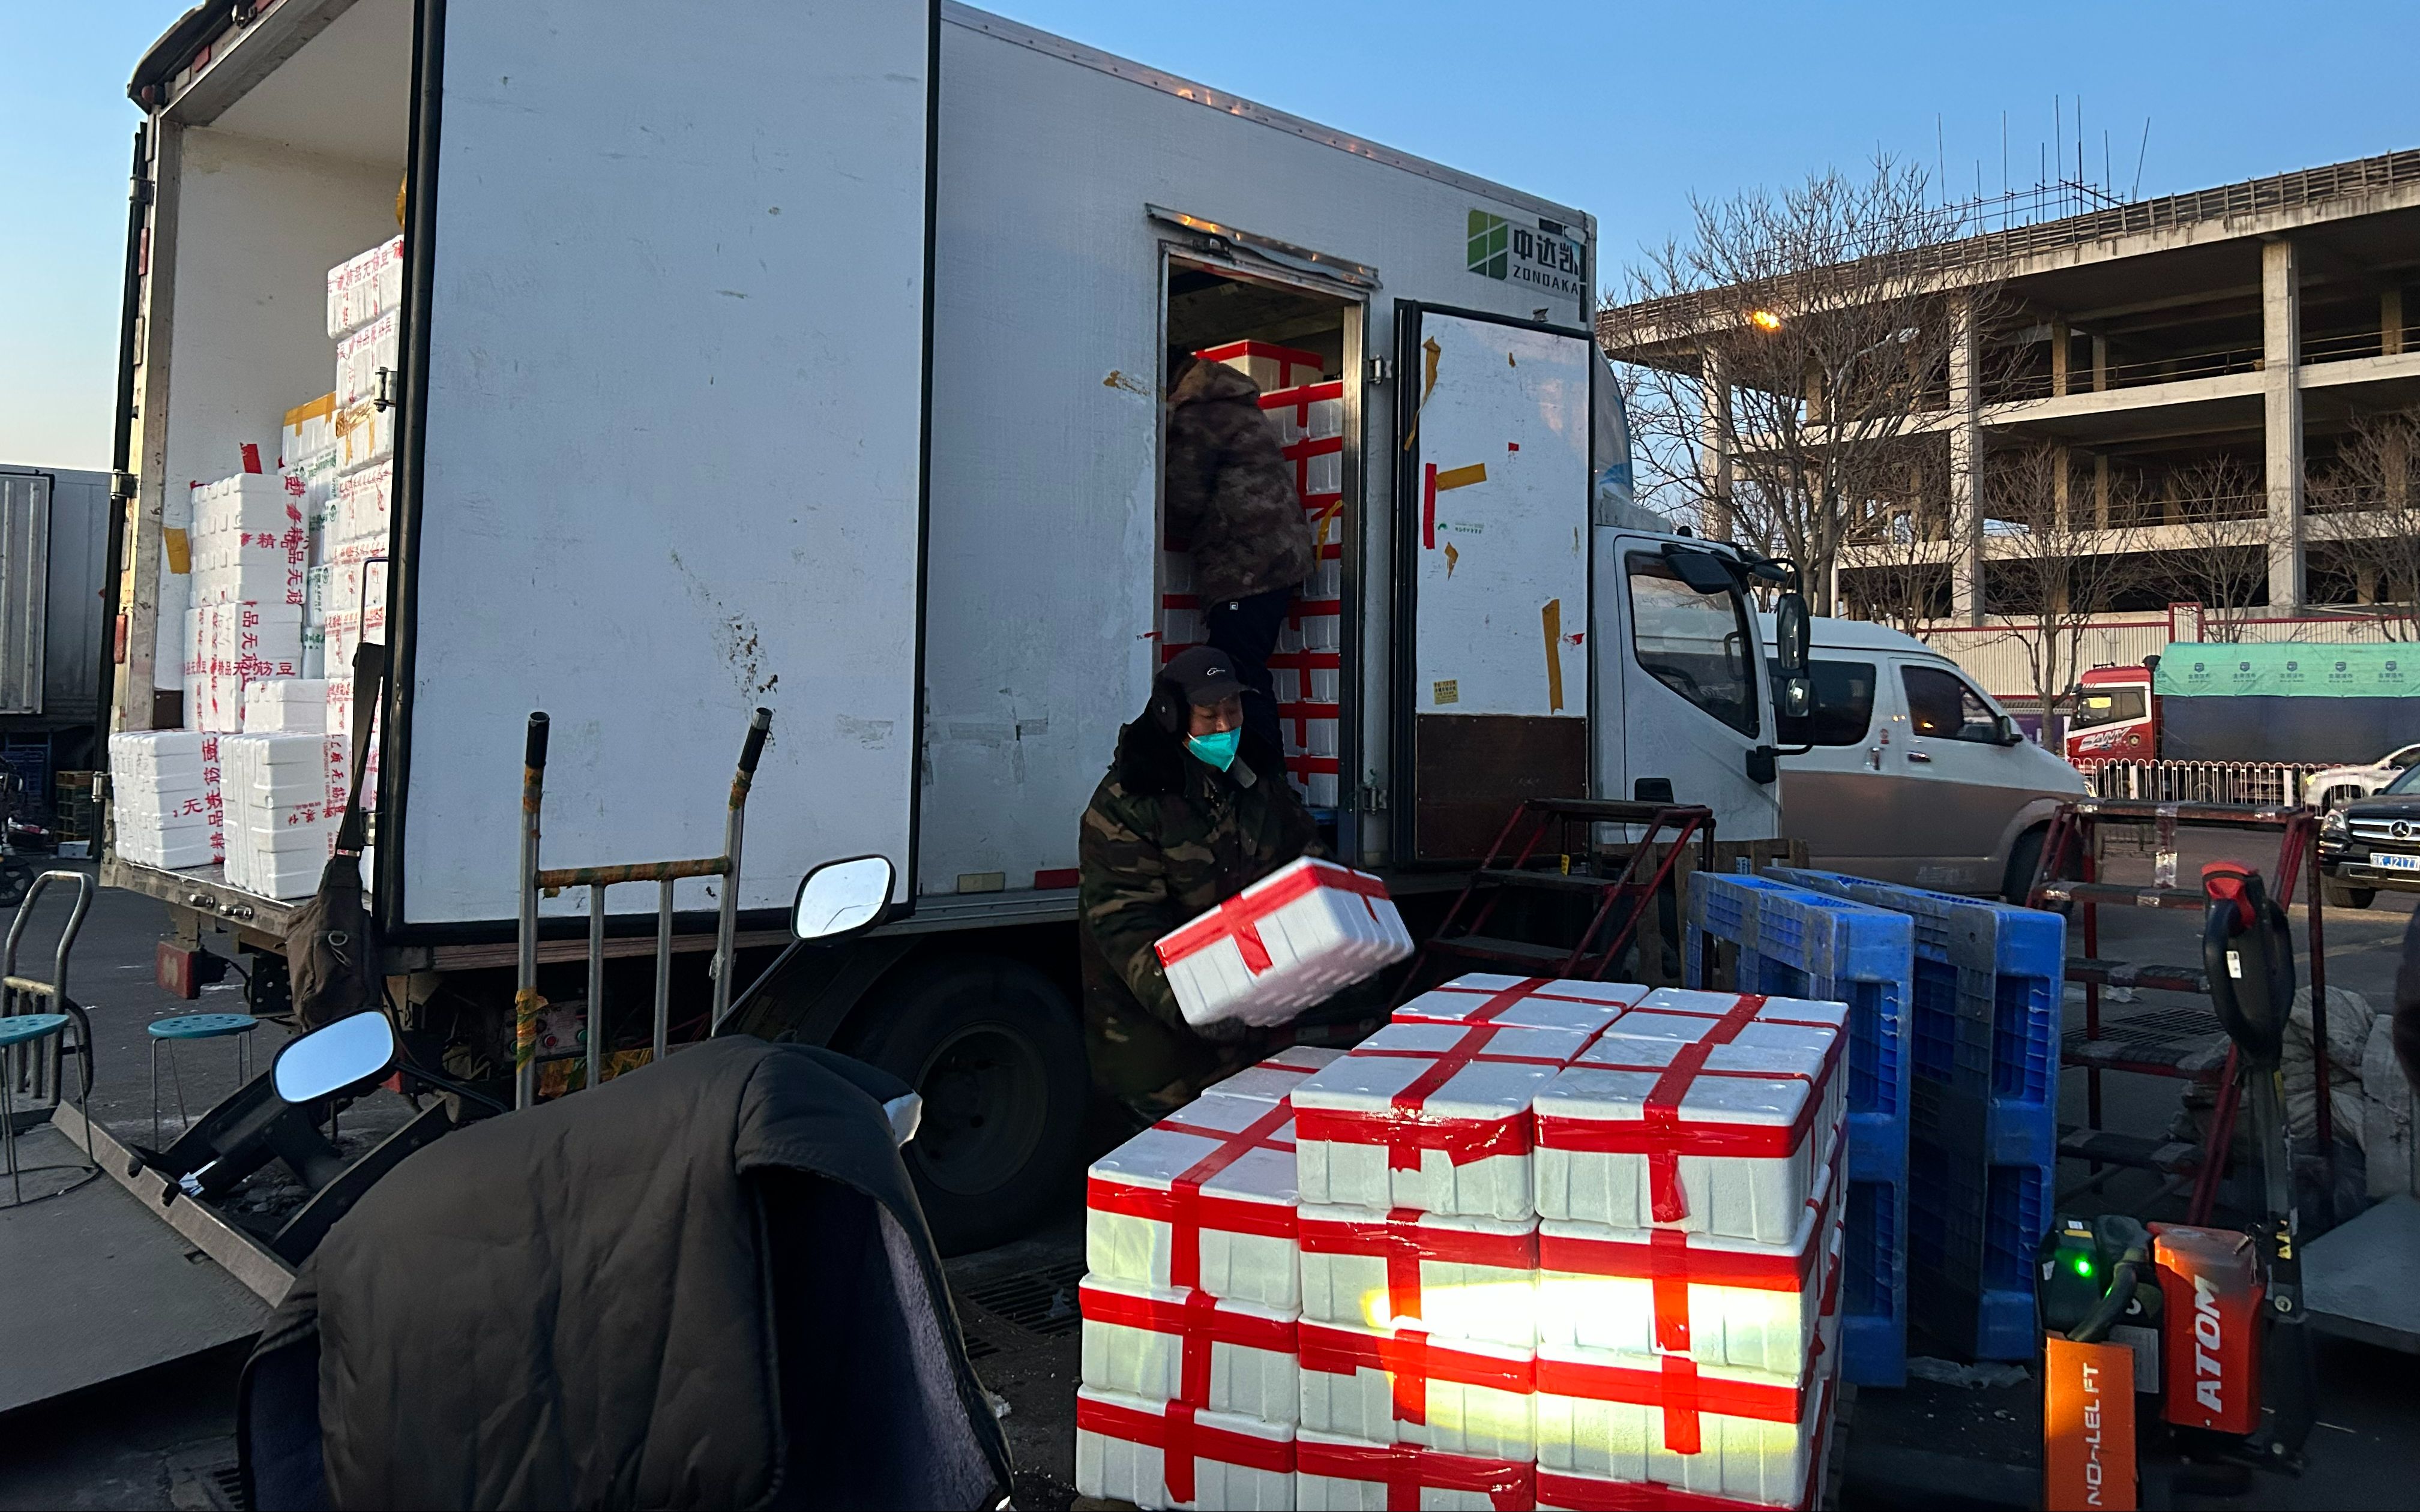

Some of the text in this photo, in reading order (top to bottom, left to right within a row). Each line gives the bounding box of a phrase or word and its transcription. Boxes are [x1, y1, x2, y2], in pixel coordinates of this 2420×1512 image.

[2078, 727, 2132, 752] SANY
[2372, 856, 2418, 869] KJ2177
[2194, 1274, 2222, 1414] ATOM
[2083, 1363, 2102, 1506] NOLELFT
